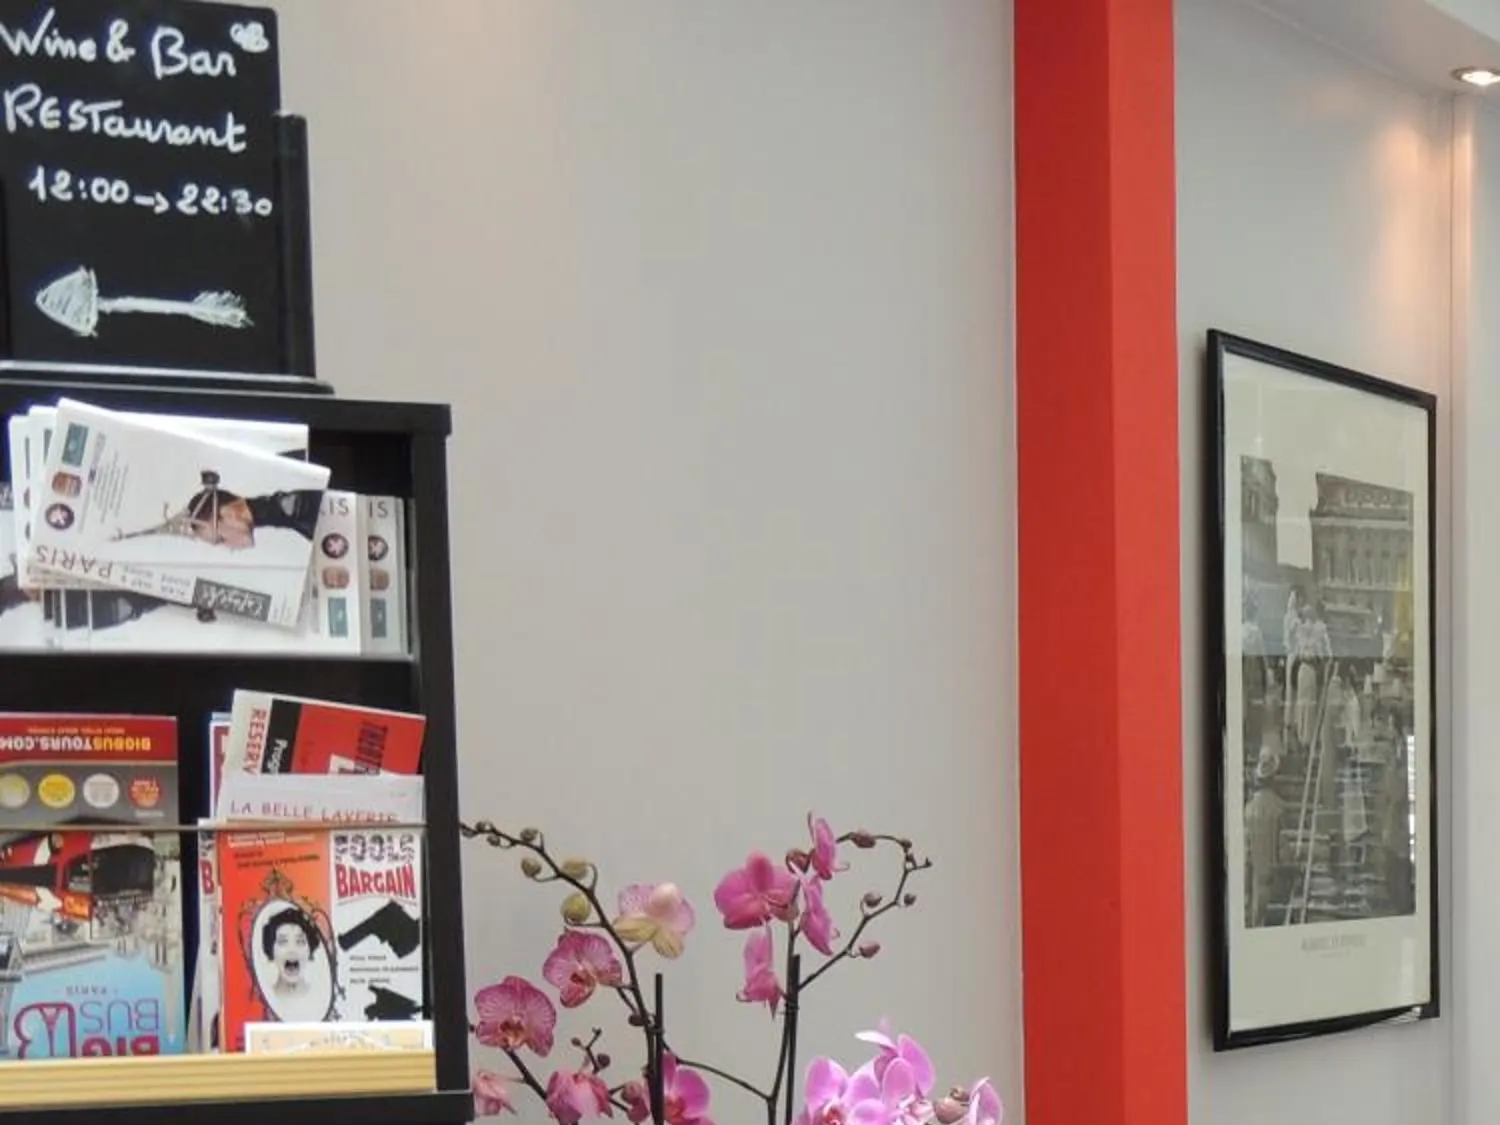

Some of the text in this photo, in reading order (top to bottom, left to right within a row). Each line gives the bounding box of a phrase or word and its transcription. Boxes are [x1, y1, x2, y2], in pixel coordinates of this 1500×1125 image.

[0, 8, 236, 80] Wine & Bar
[36, 545, 113, 578] PARIS
[335, 862, 416, 899] BARGAIN
[79, 998, 160, 1032] BUS
